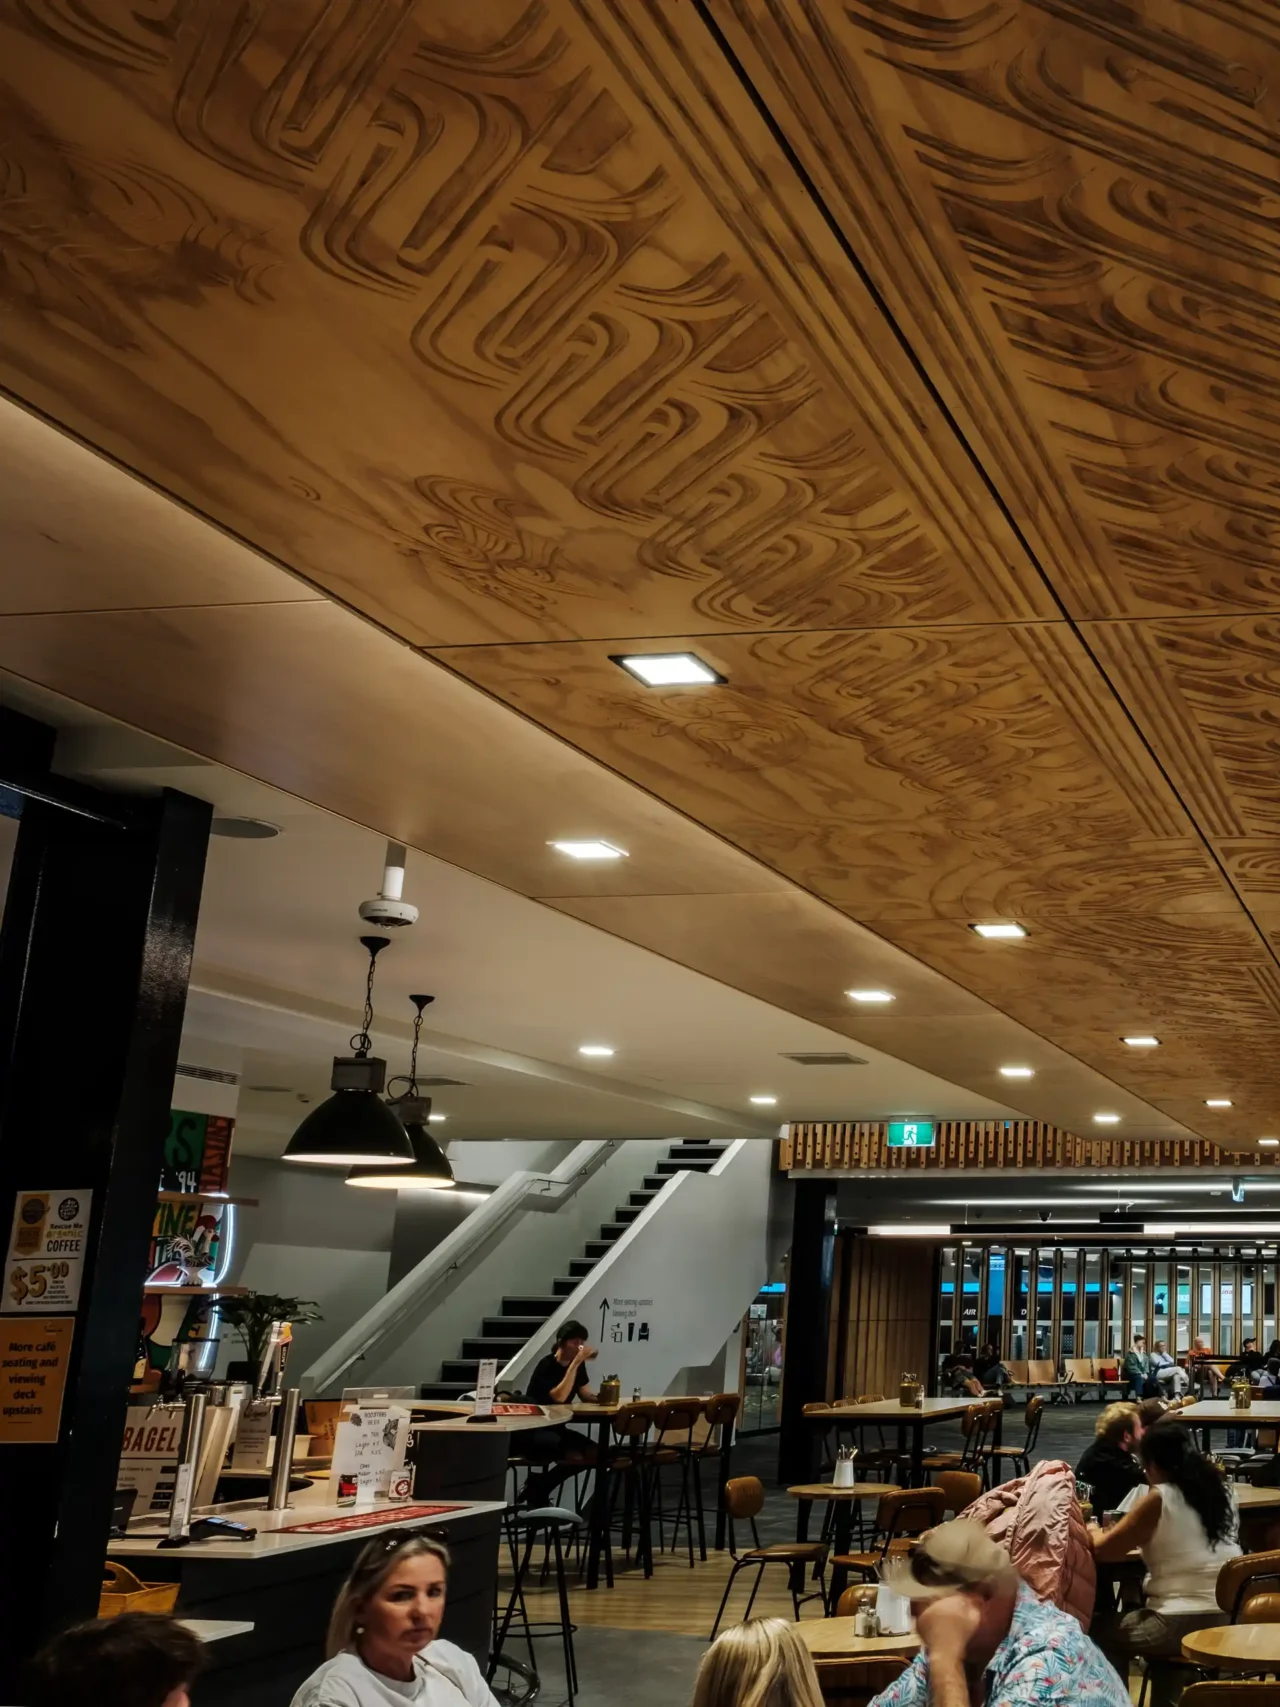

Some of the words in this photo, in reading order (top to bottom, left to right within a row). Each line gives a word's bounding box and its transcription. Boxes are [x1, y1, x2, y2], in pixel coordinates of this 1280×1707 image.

[176, 1170, 197, 1194] '94
[47, 1239, 81, 1252] COFFEE
[963, 1308, 976, 1316] AIR
[9, 1342, 33, 1352] More
[36, 1340, 56, 1352] café
[2, 1357, 38, 1369] seating
[39, 1357, 58, 1367] and
[8, 1373, 46, 1386] viewing
[13, 1390, 36, 1400] deck
[3, 1404, 42, 1417] upstairs
[122, 1426, 179, 1452] BAGEL
